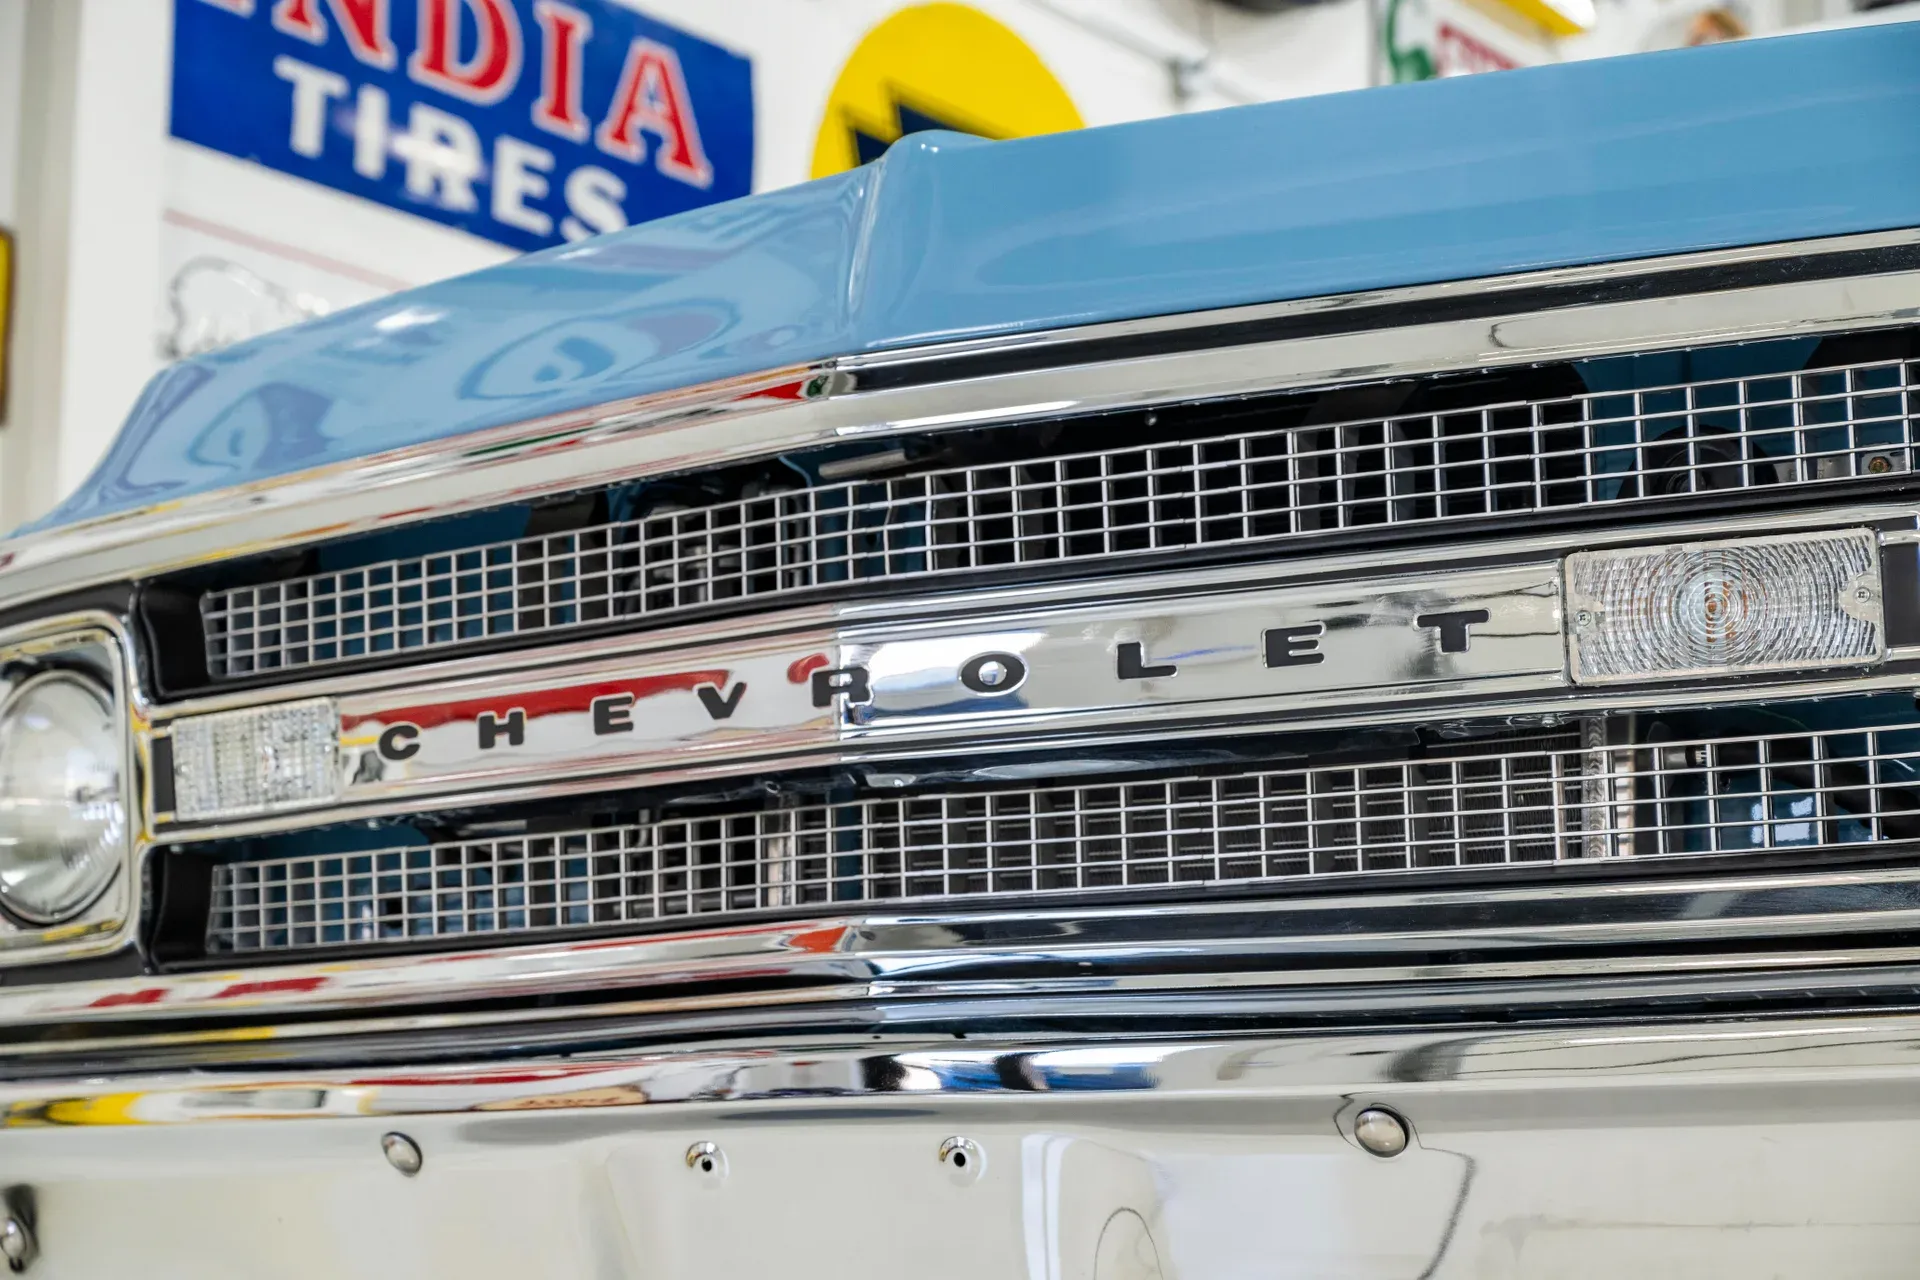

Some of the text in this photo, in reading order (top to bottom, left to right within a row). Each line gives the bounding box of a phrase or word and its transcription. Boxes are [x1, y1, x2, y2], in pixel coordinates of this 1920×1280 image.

[196, 0, 713, 189] DIA
[272, 56, 628, 242] TIRES
[378, 607, 1491, 760] CHEVROLET
